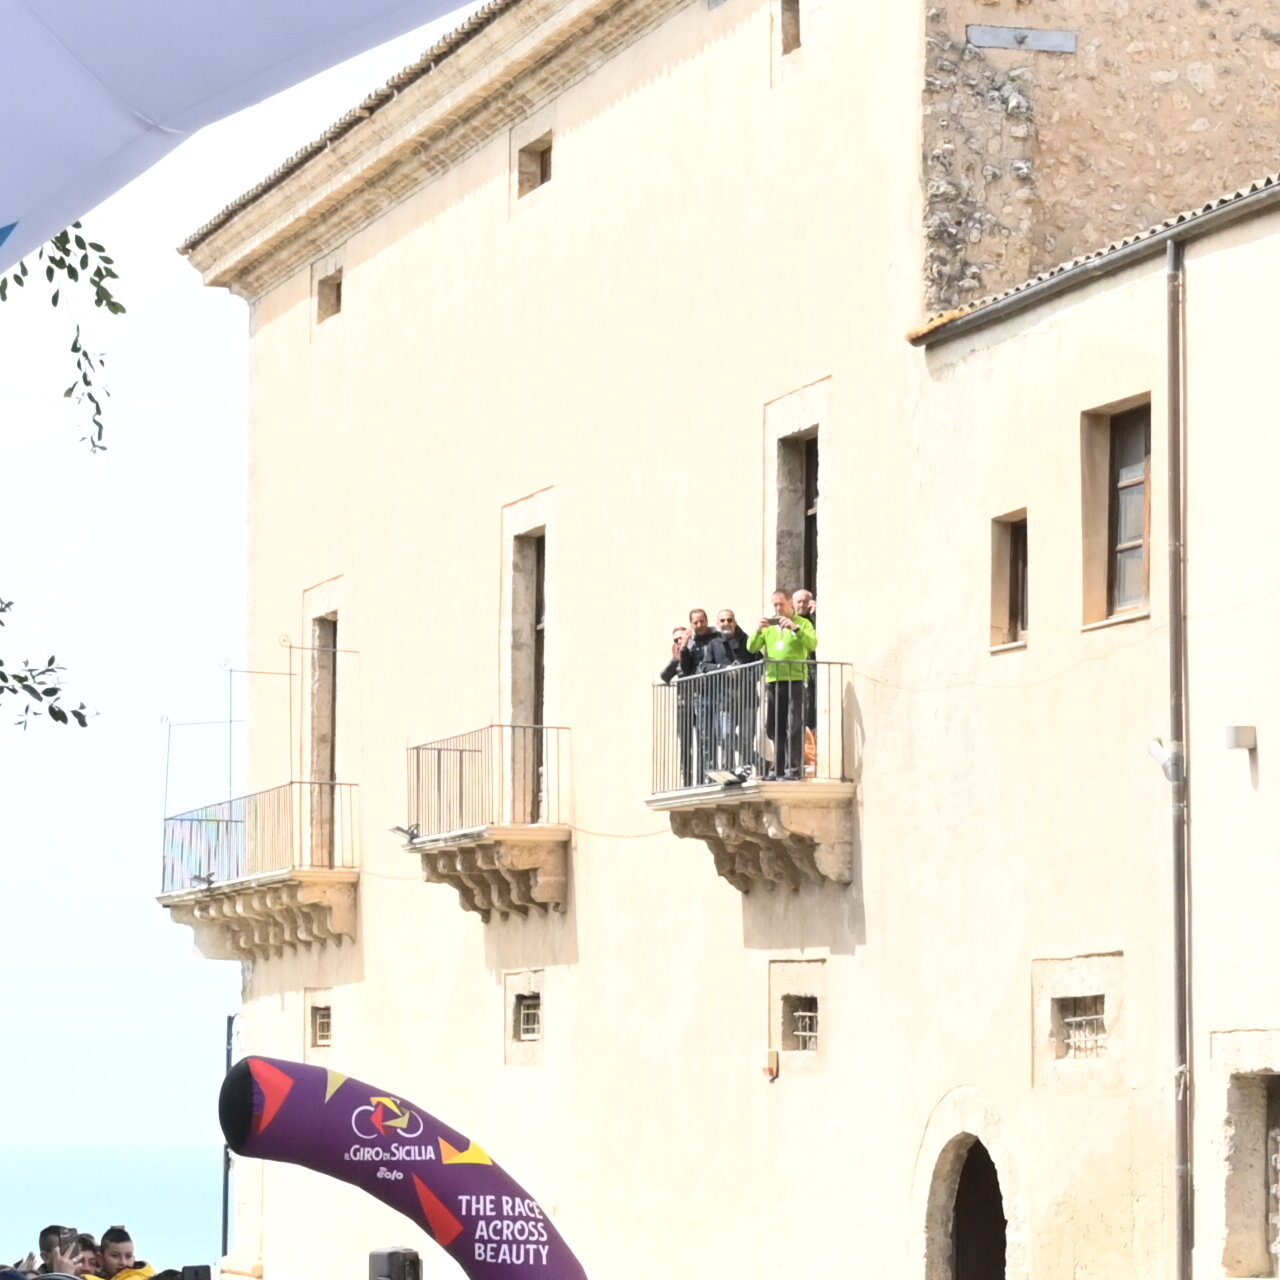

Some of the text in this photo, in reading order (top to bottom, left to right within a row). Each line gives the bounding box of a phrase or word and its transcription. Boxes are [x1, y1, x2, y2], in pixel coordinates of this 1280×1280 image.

[350, 1144, 383, 1161] GIRO
[390, 1142, 436, 1161] SICILIA
[458, 1195, 544, 1220] THE RACE
[474, 1219, 548, 1242] ACROSS
[474, 1242, 549, 1266] BEAUTY
